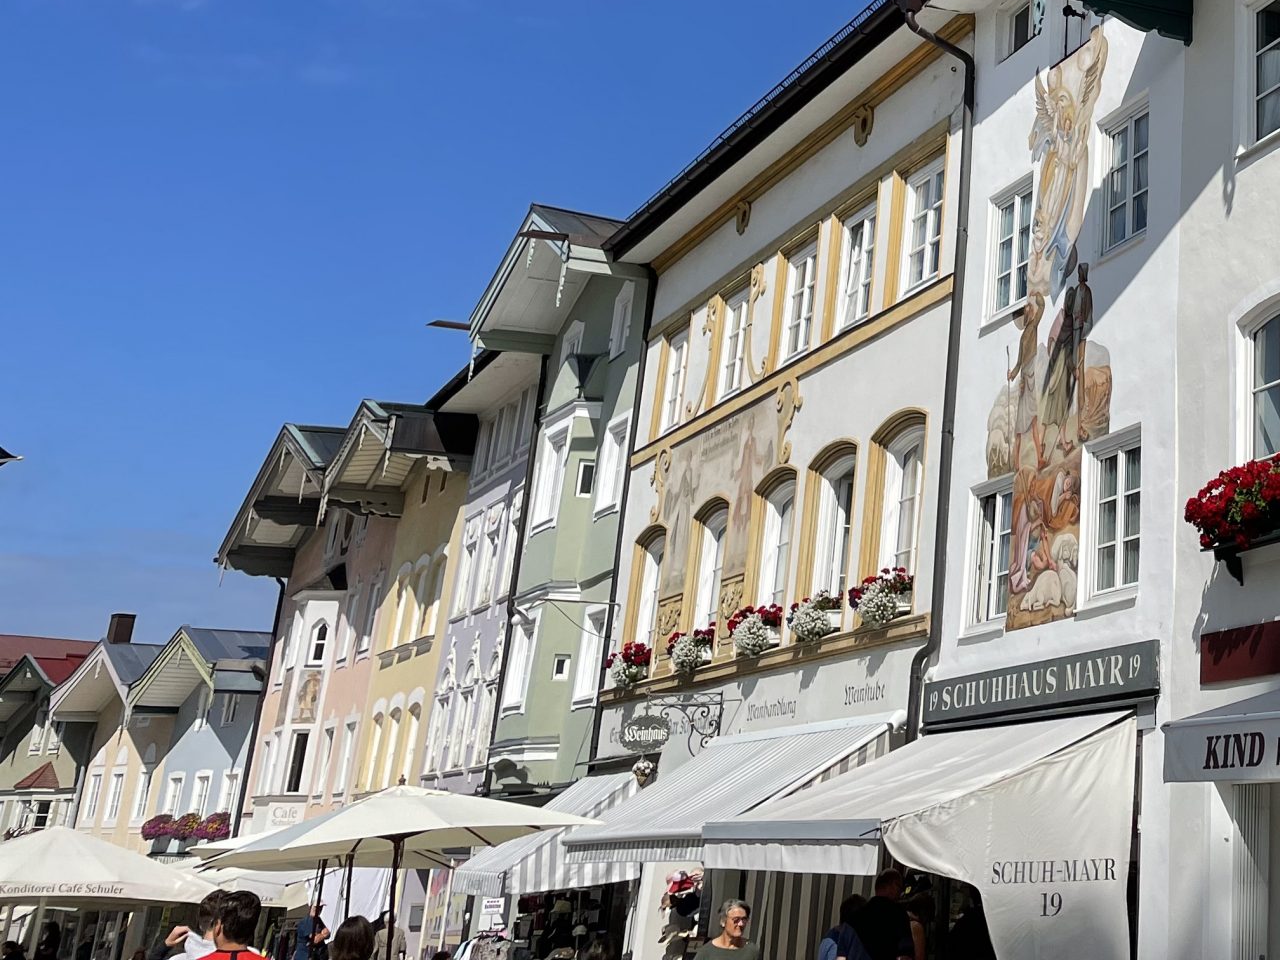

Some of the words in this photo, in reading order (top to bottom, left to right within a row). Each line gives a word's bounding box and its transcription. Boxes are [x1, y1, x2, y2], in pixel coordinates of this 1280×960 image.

[928, 691, 938, 711] 19
[941, 666, 1057, 710] SCHUHHAUS
[1065, 654, 1124, 691] MAYR
[1128, 654, 1141, 678] 19
[624, 724, 668, 743] Weinhaus
[1203, 732, 1265, 769] KIND
[991, 858, 1117, 884] SCHUH-MAYR
[0, 883, 55, 895] Konditorei
[58, 883, 82, 894] Café
[85, 883, 124, 895] Schuler
[1040, 892, 1063, 917] 19
